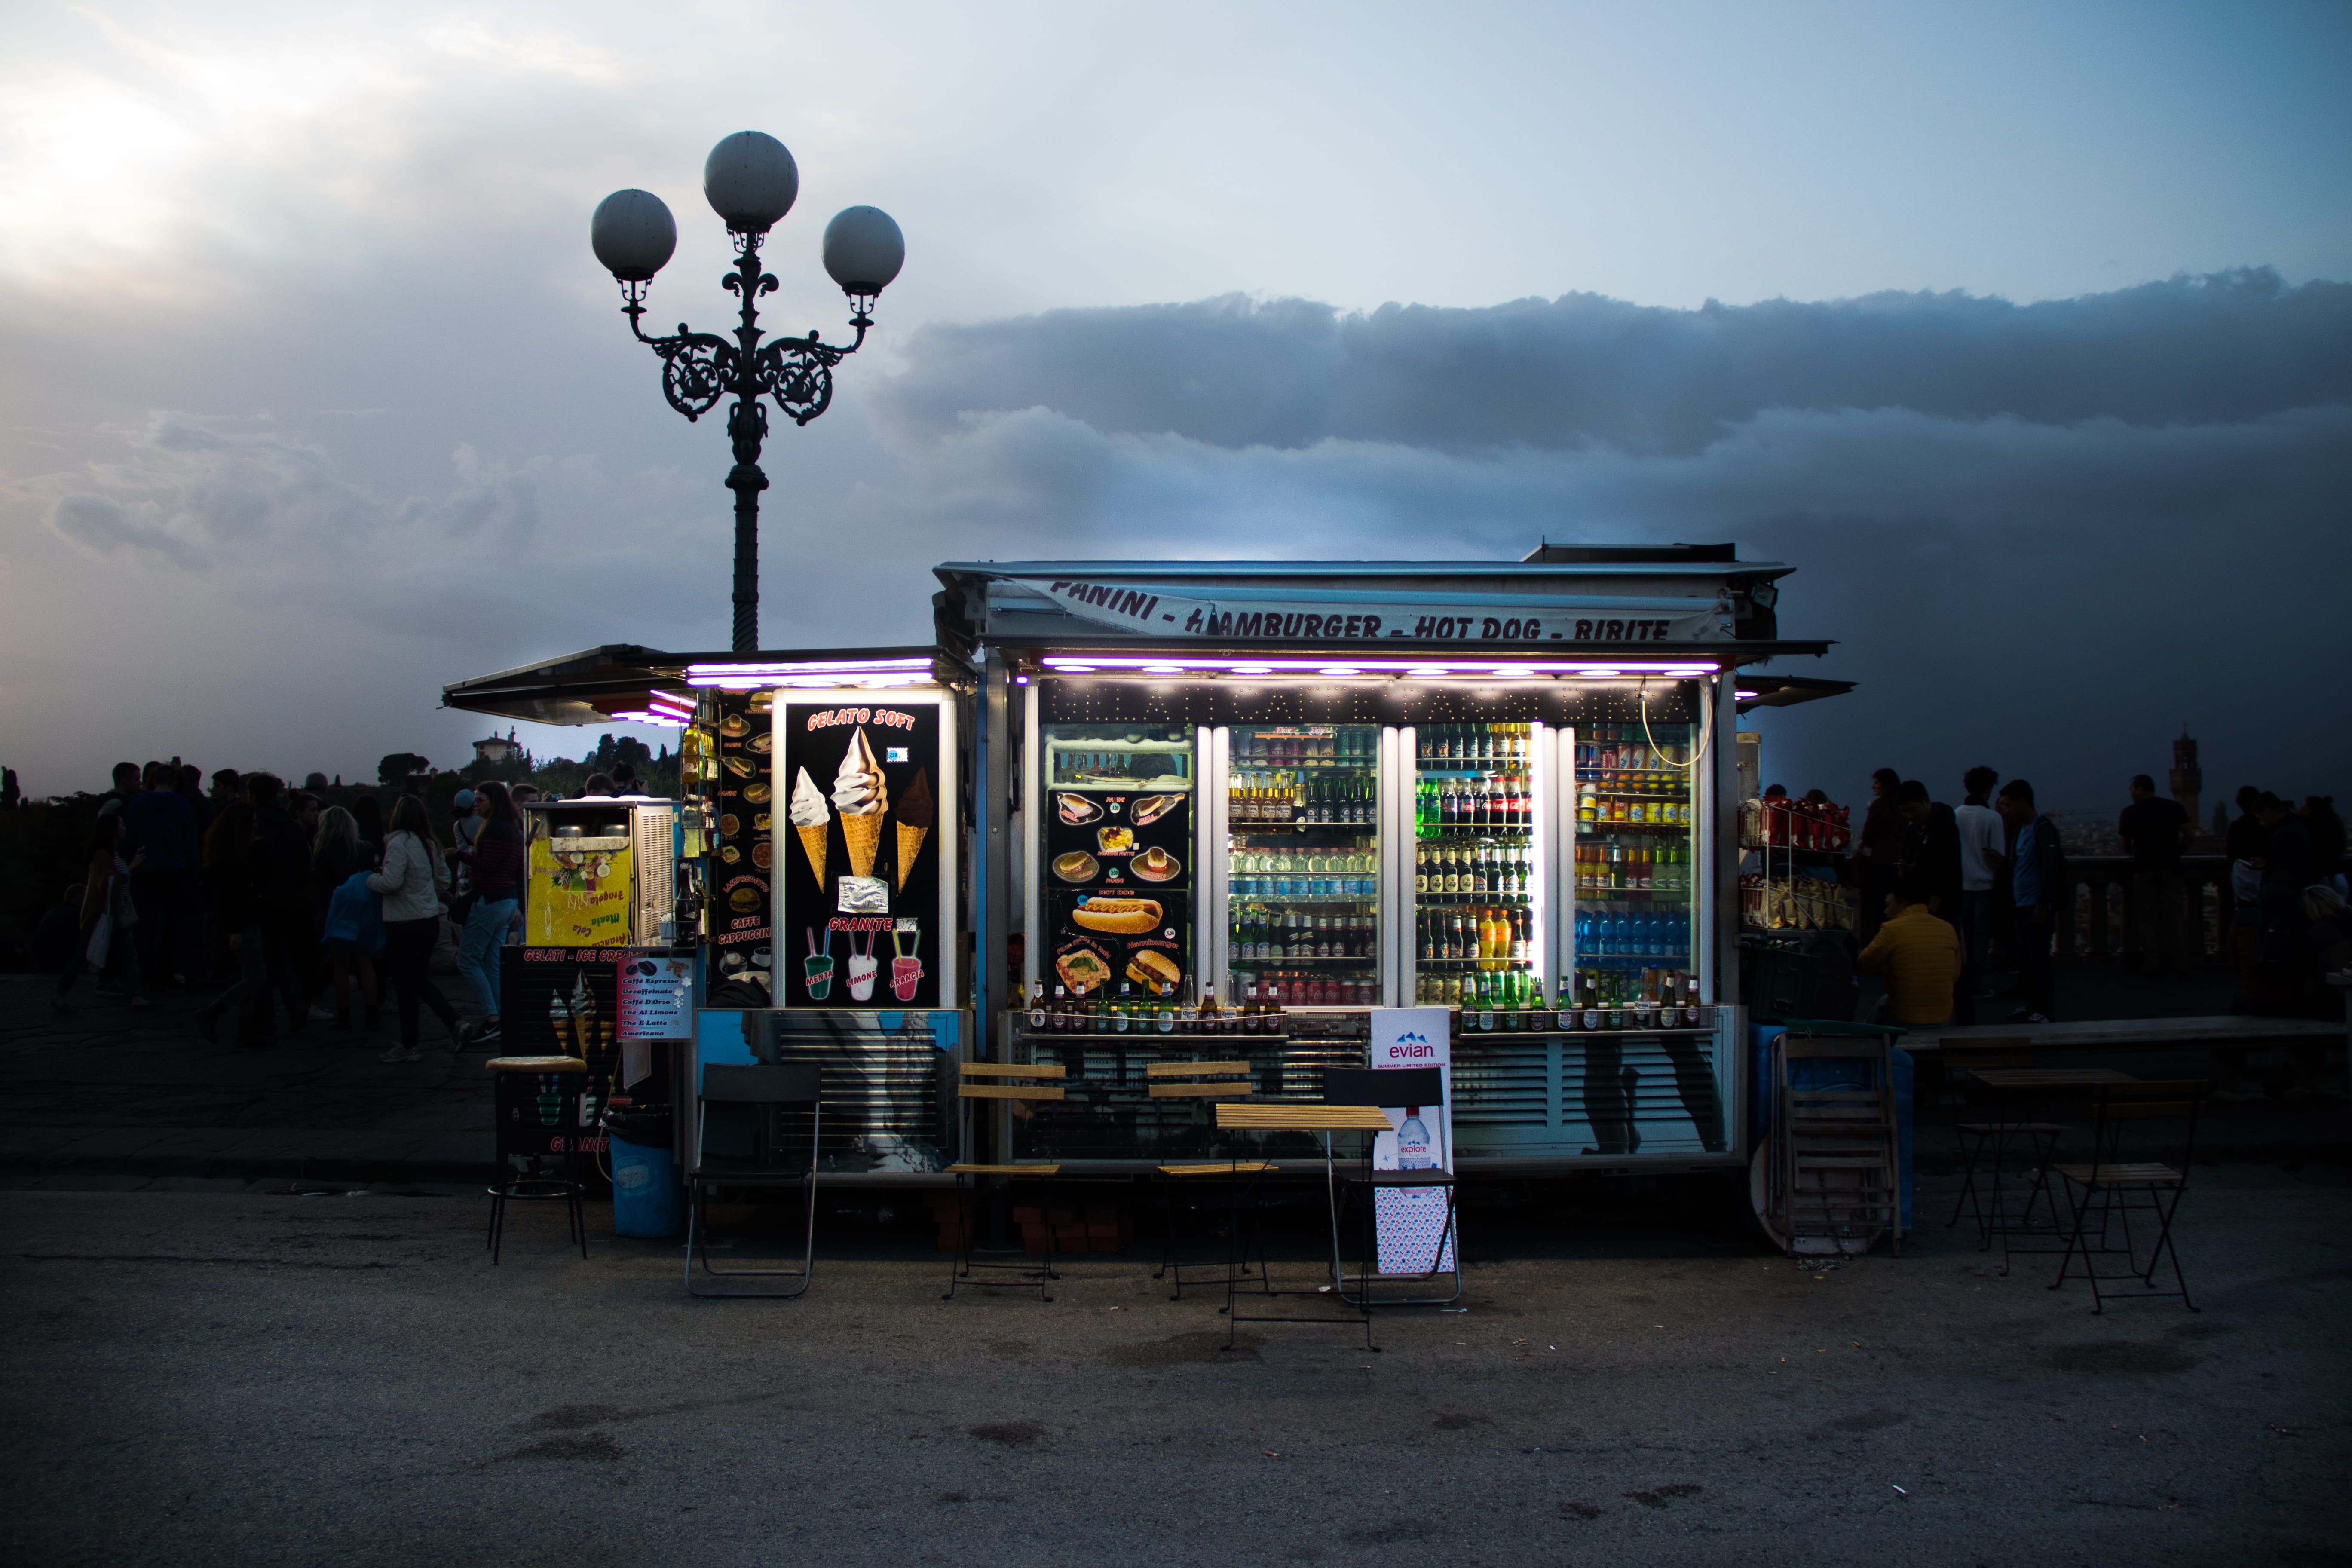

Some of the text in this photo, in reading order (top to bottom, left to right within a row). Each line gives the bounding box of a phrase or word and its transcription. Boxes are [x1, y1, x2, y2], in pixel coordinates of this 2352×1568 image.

[1050, 581, 1159, 620] PANINI
[1185, 608, 1382, 637] HAMBURGER
[1415, 616, 1473, 639] HOT
[1481, 618, 1541, 639] DOG
[807, 707, 915, 731] GELATO SOFT
[723, 875, 770, 893] LAMPREDOTTO
[591, 913, 620, 927] Menta
[731, 916, 760, 929] CAFFE
[829, 917, 894, 931] GRANITE
[572, 924, 592, 938] Cola
[1127, 938, 1179, 949] Hamburger
[524, 949, 566, 962] GELATI
[576, 949, 596, 962] ICE
[805, 970, 833, 986] MENTA
[846, 970, 877, 987] LIMONE
[889, 969, 925, 988] ARANCIA
[1401, 1145, 1427, 1154] explore
